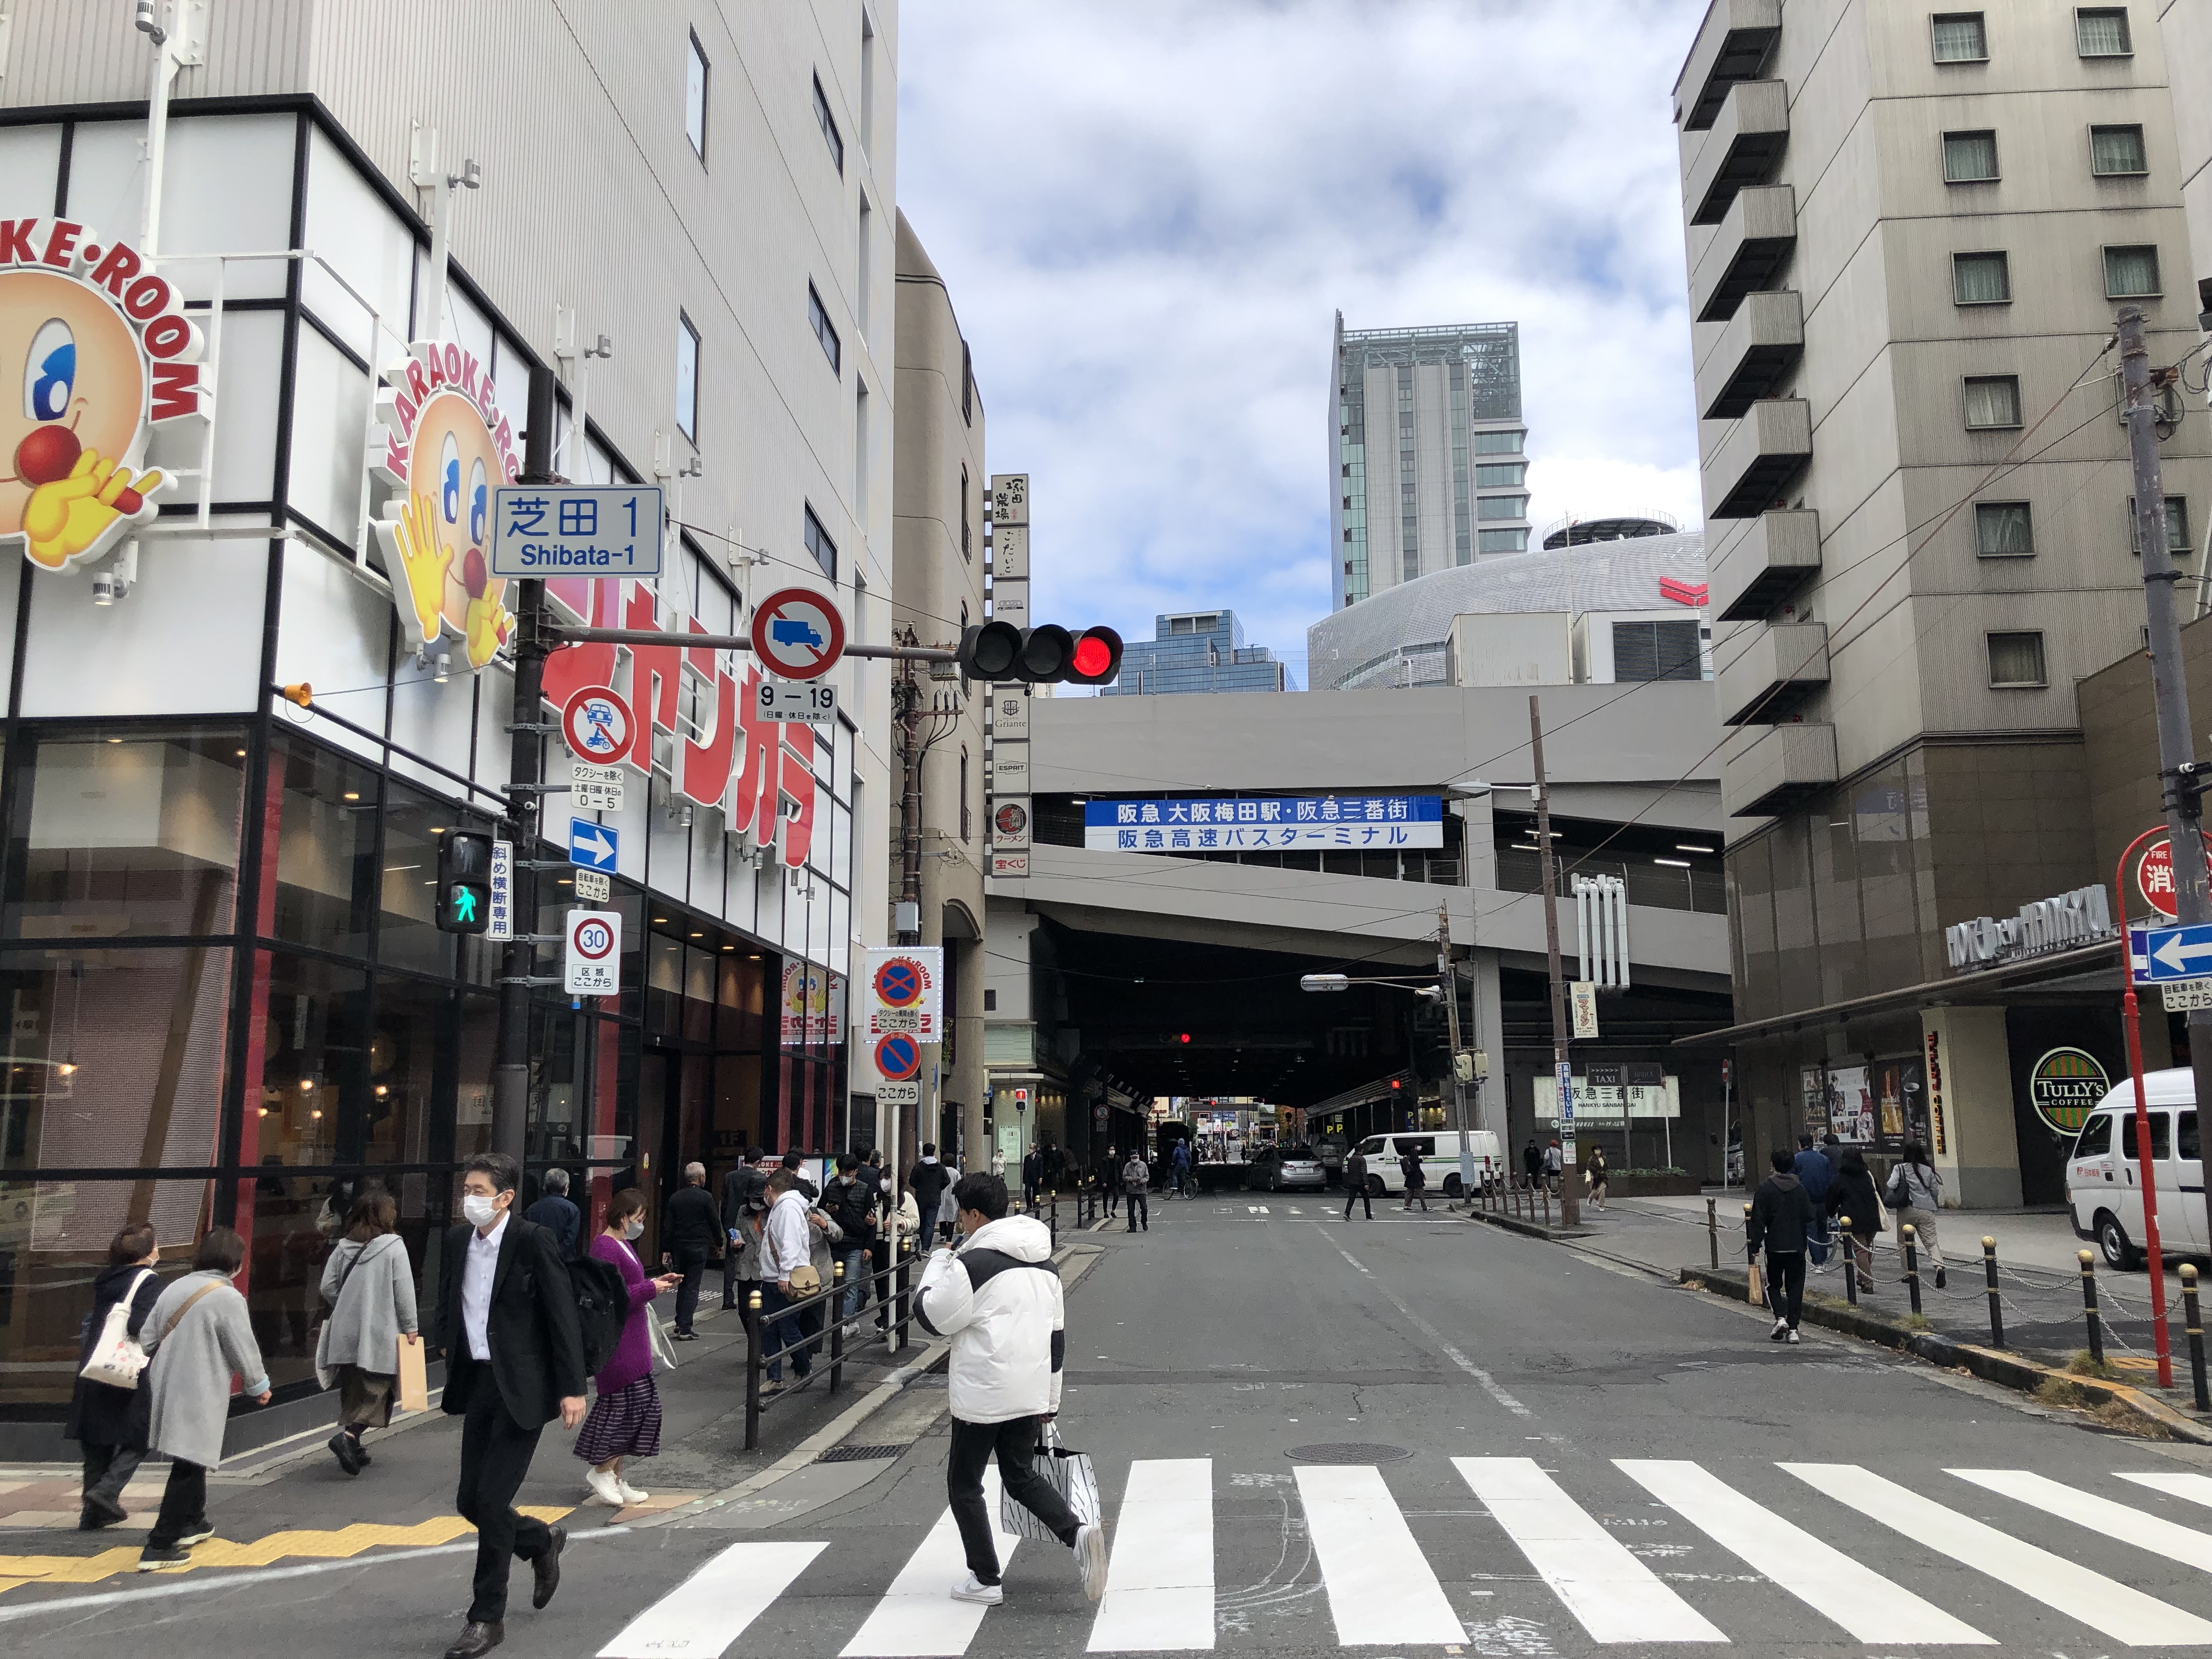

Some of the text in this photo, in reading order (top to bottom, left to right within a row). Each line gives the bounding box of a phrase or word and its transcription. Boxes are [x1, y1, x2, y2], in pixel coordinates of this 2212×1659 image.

[507, 497, 598, 537] 芝田
[521, 544, 635, 566] Shibata-1
[995, 719, 1026, 727] Griante
[574, 767, 622, 781] タクシーを除く
[996, 808, 1023, 829] 一蘭
[1118, 827, 1409, 849] 阪急高速バスターミナル
[996, 859, 1025, 869] 宝くじ
[578, 872, 608, 887] 自転車を除く
[493, 847, 507, 934] 斜め横断専用
[578, 883, 608, 900] ここから
[583, 930, 605, 948] 30
[574, 977, 612, 987] ここから
[2165, 982, 2210, 994] 自転車を除く
[2166, 994, 2212, 1008] ここから
[879, 1019, 917, 1028] ここから
[878, 1087, 916, 1099] ここから
